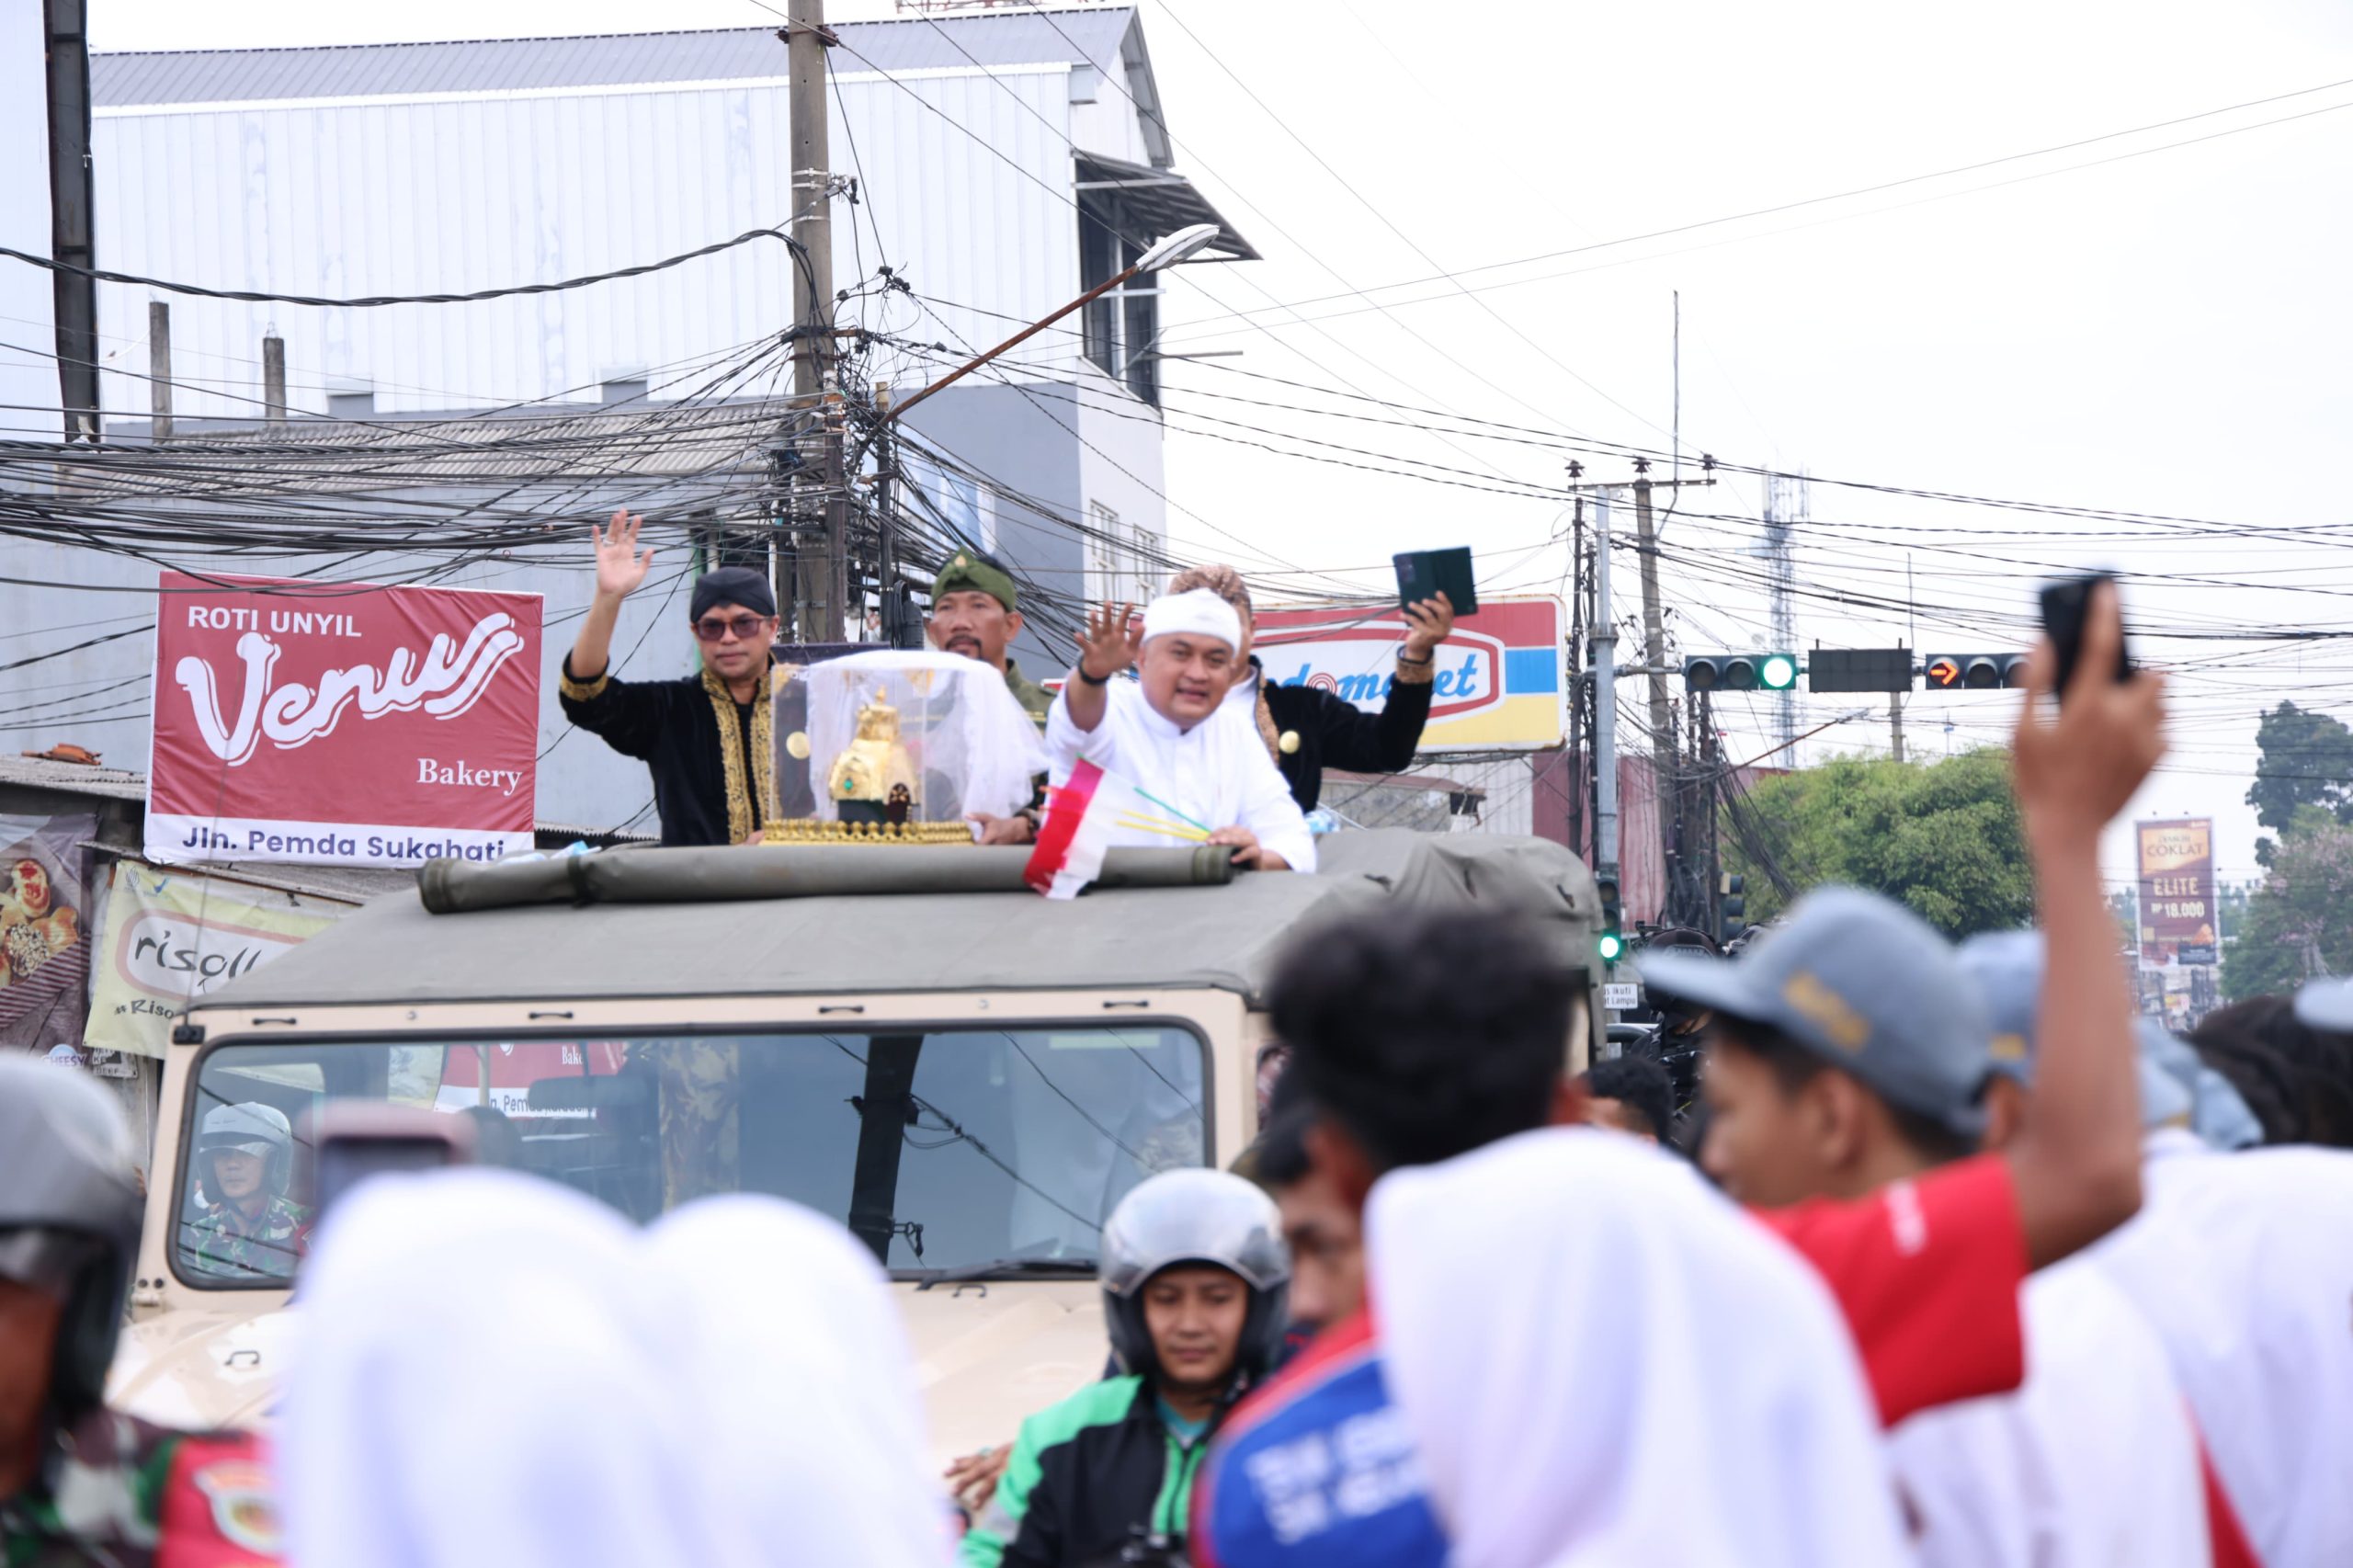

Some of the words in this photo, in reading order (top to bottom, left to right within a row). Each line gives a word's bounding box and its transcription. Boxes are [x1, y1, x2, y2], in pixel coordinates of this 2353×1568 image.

[188, 606, 258, 631] ROTI
[270, 610, 362, 637] UNYIL
[176, 612, 524, 767] Venus
[416, 758, 522, 796] Bakery
[183, 826, 237, 850] Jln.
[247, 830, 356, 857] Pemda
[368, 835, 504, 862] Sukahati
[2146, 842, 2203, 857] COKLAT
[2153, 877, 2200, 897] ELITE
[135, 930, 262, 980] risoll
